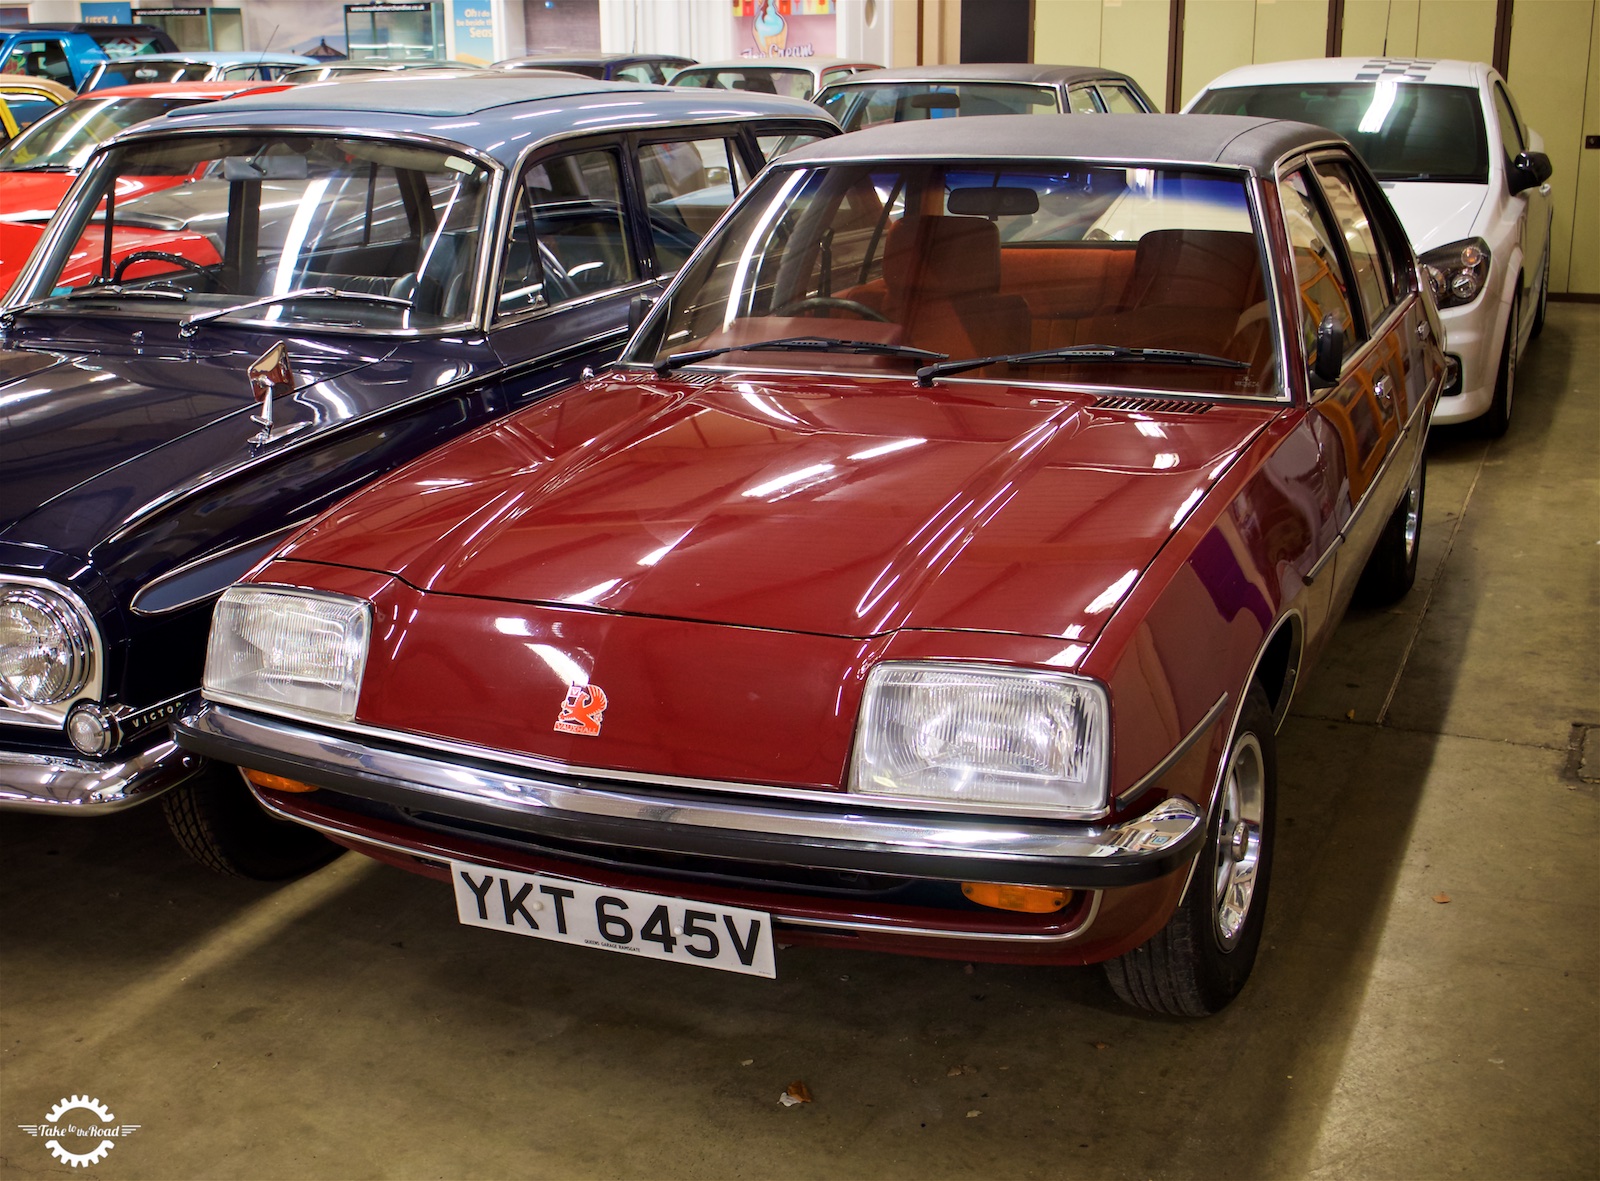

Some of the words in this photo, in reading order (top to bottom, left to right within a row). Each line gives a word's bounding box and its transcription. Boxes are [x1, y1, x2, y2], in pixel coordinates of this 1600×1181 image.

[464, 8, 477, 17] Oh
[769, 43, 815, 58] Cream
[555, 722, 598, 734] VAUXHALL
[460, 871, 574, 935] YKT
[595, 894, 761, 967] 645V
[601, 941, 617, 949] GARAGE
[618, 944, 641, 953] RAMSGATE
